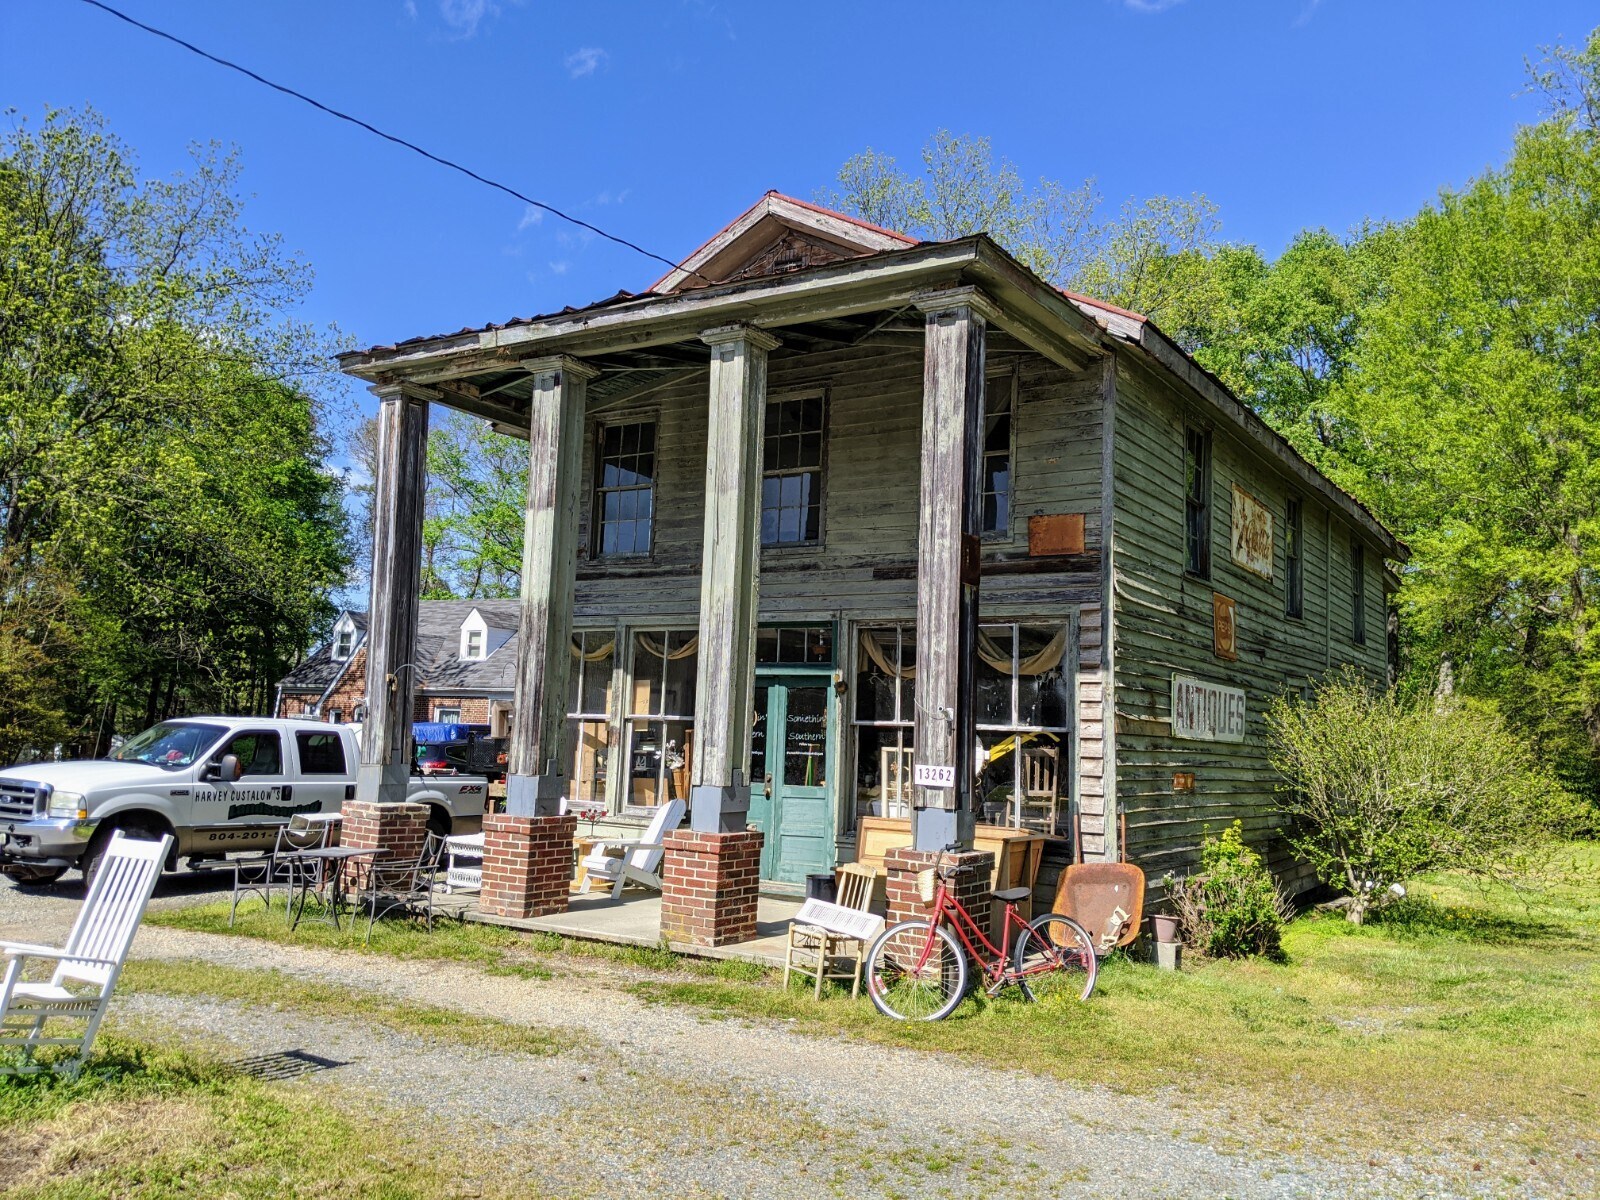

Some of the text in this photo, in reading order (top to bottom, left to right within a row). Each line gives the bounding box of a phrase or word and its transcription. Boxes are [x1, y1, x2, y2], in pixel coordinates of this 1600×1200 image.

[1175, 683, 1245, 737] ANTIQUES
[788, 732, 825, 741] Southern
[919, 767, 951, 781] 13262
[195, 790, 228, 802] HARVEY
[230, 789, 281, 801] CUSTALOW'S
